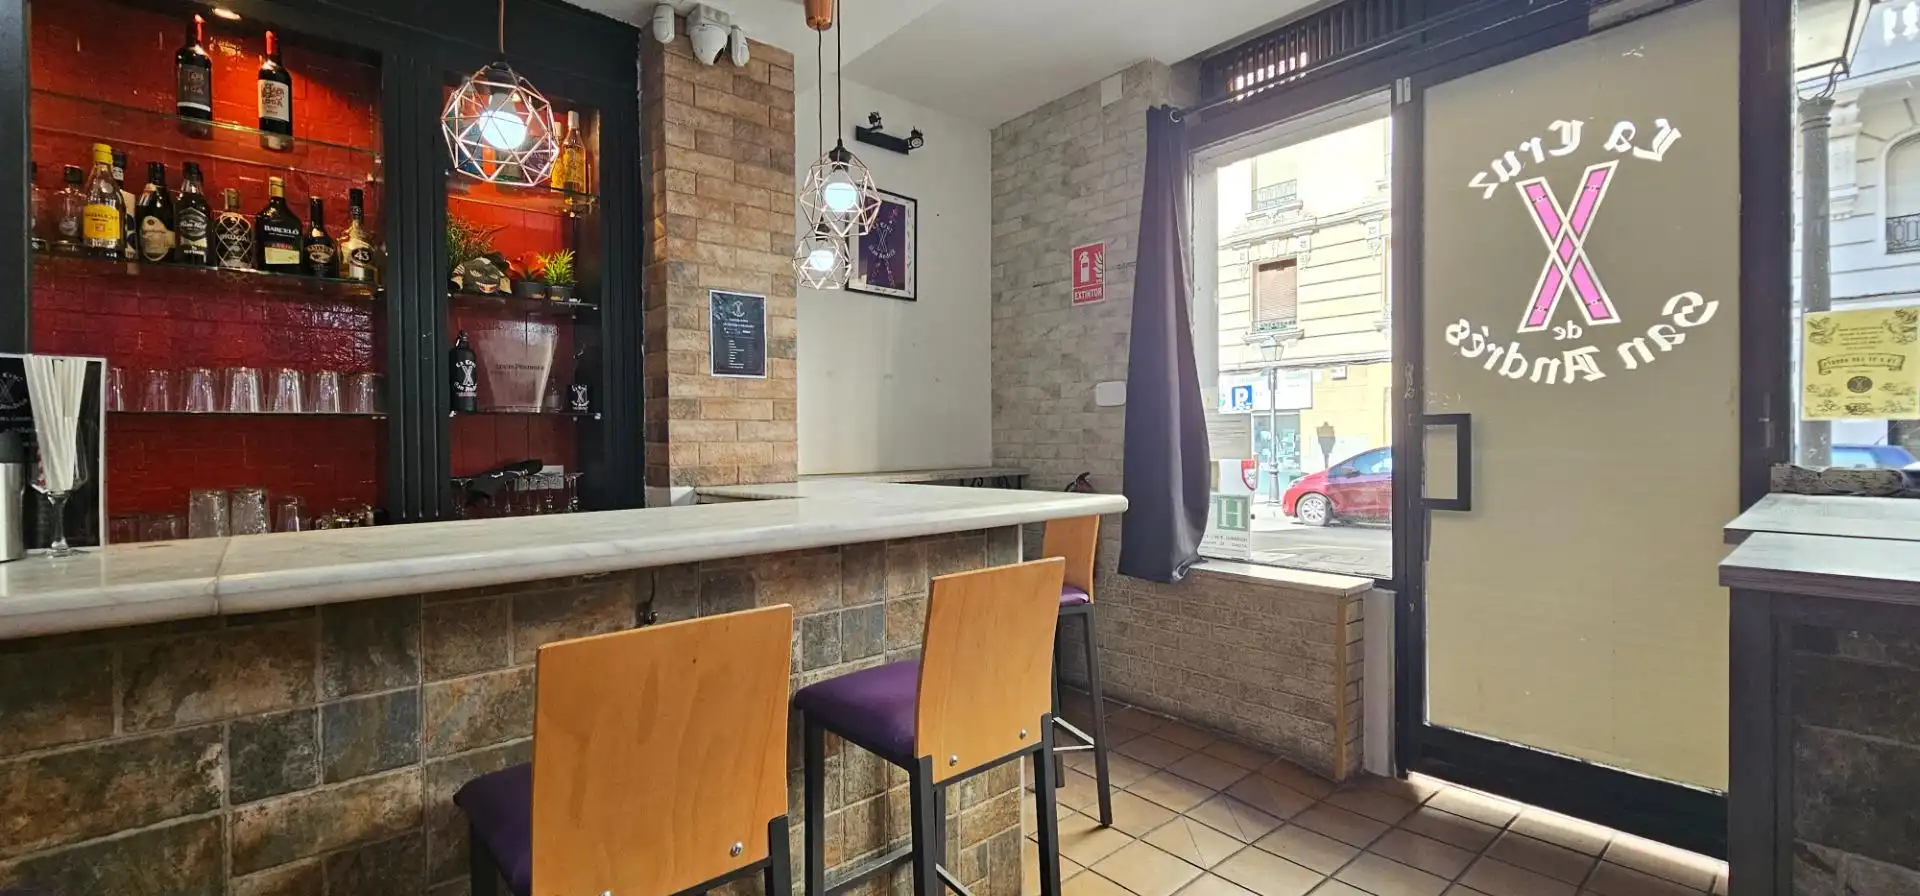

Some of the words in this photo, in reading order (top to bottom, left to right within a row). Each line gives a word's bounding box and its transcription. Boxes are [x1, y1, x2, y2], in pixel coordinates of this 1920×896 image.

[264, 225, 299, 235] BARCELÓ
[355, 251, 369, 260] 43
[1074, 287, 1103, 301] EXTINTOR
